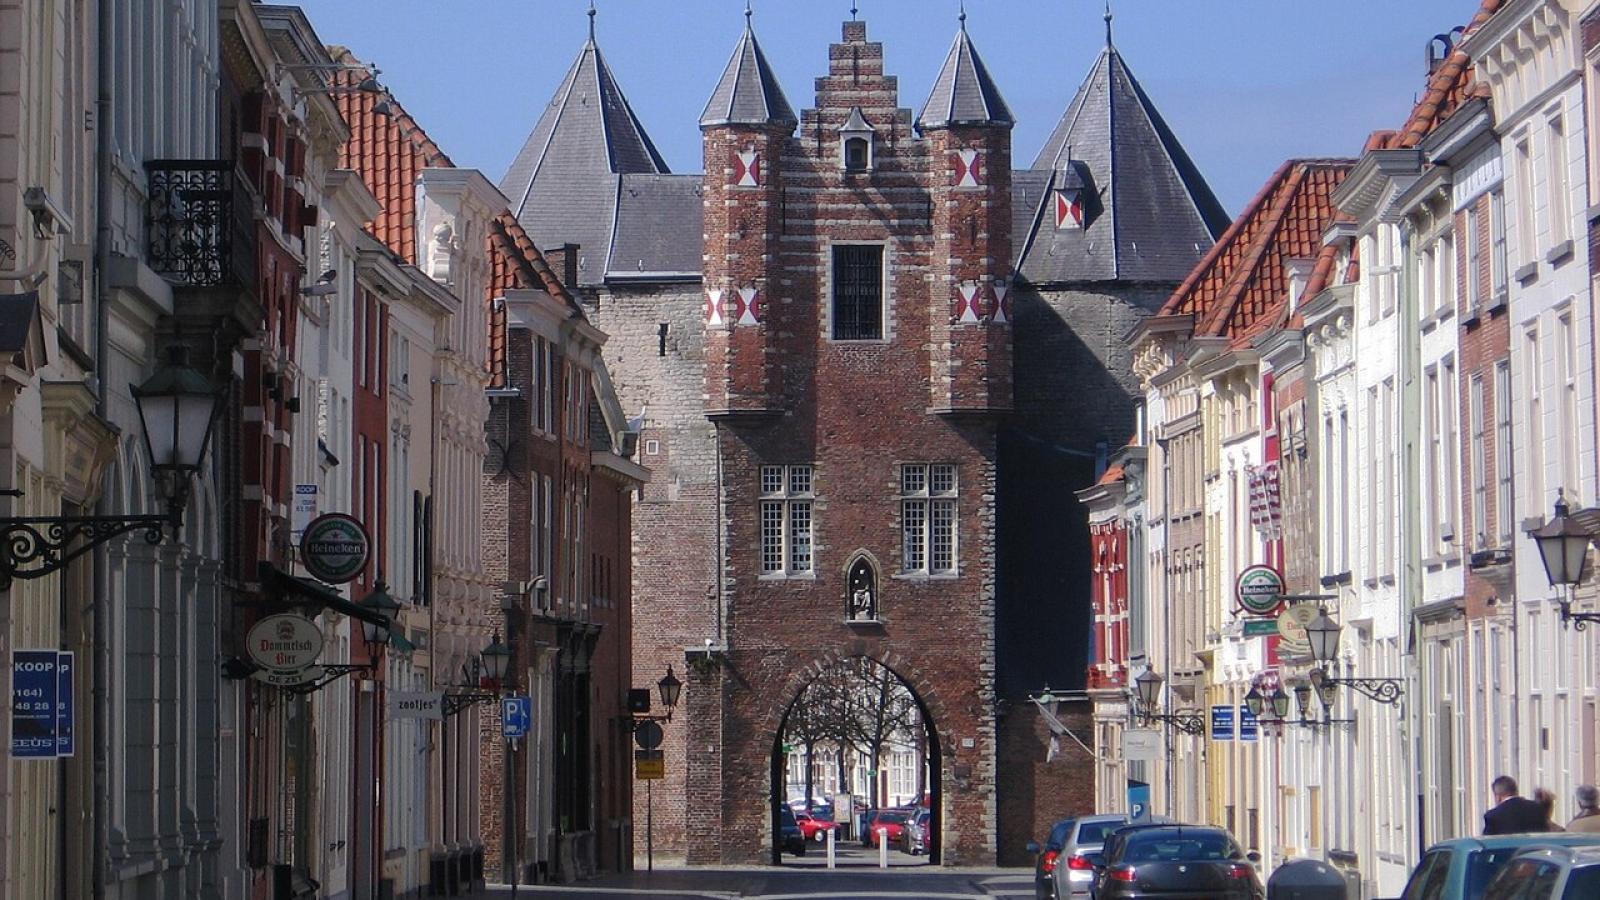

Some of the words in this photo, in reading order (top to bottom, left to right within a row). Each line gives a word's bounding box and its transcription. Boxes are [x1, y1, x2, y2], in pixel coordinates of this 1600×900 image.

[311, 543, 361, 553] Heineken
[15, 662, 54, 672] KOOP
[506, 702, 518, 721] P
[1132, 804, 1142, 817] P
